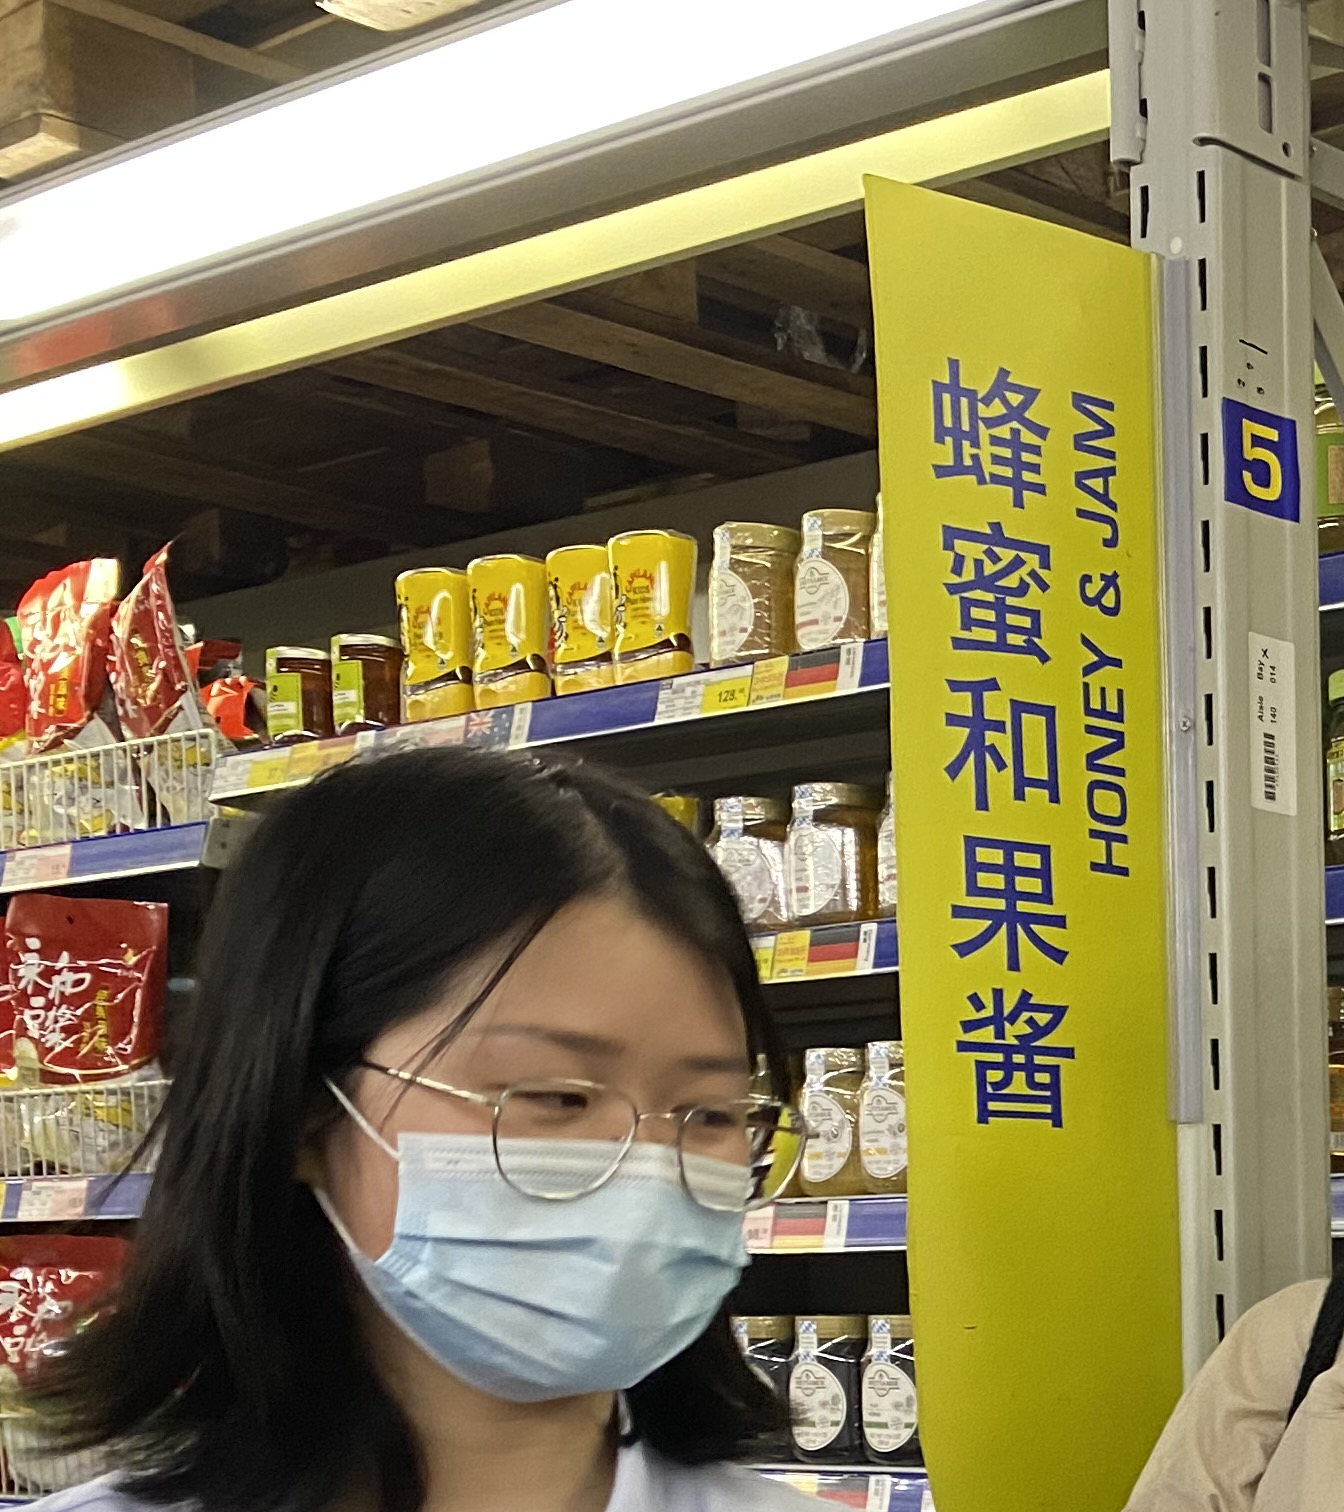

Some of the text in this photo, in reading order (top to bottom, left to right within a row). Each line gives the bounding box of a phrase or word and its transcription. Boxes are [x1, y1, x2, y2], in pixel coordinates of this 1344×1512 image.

[1242, 418, 1282, 501] 5
[931, 357, 1077, 1128] 蜂蜜和果酱
[1070, 392, 1132, 878] HONEY & JAM
[1256, 659, 1265, 722] Aisle Bay
